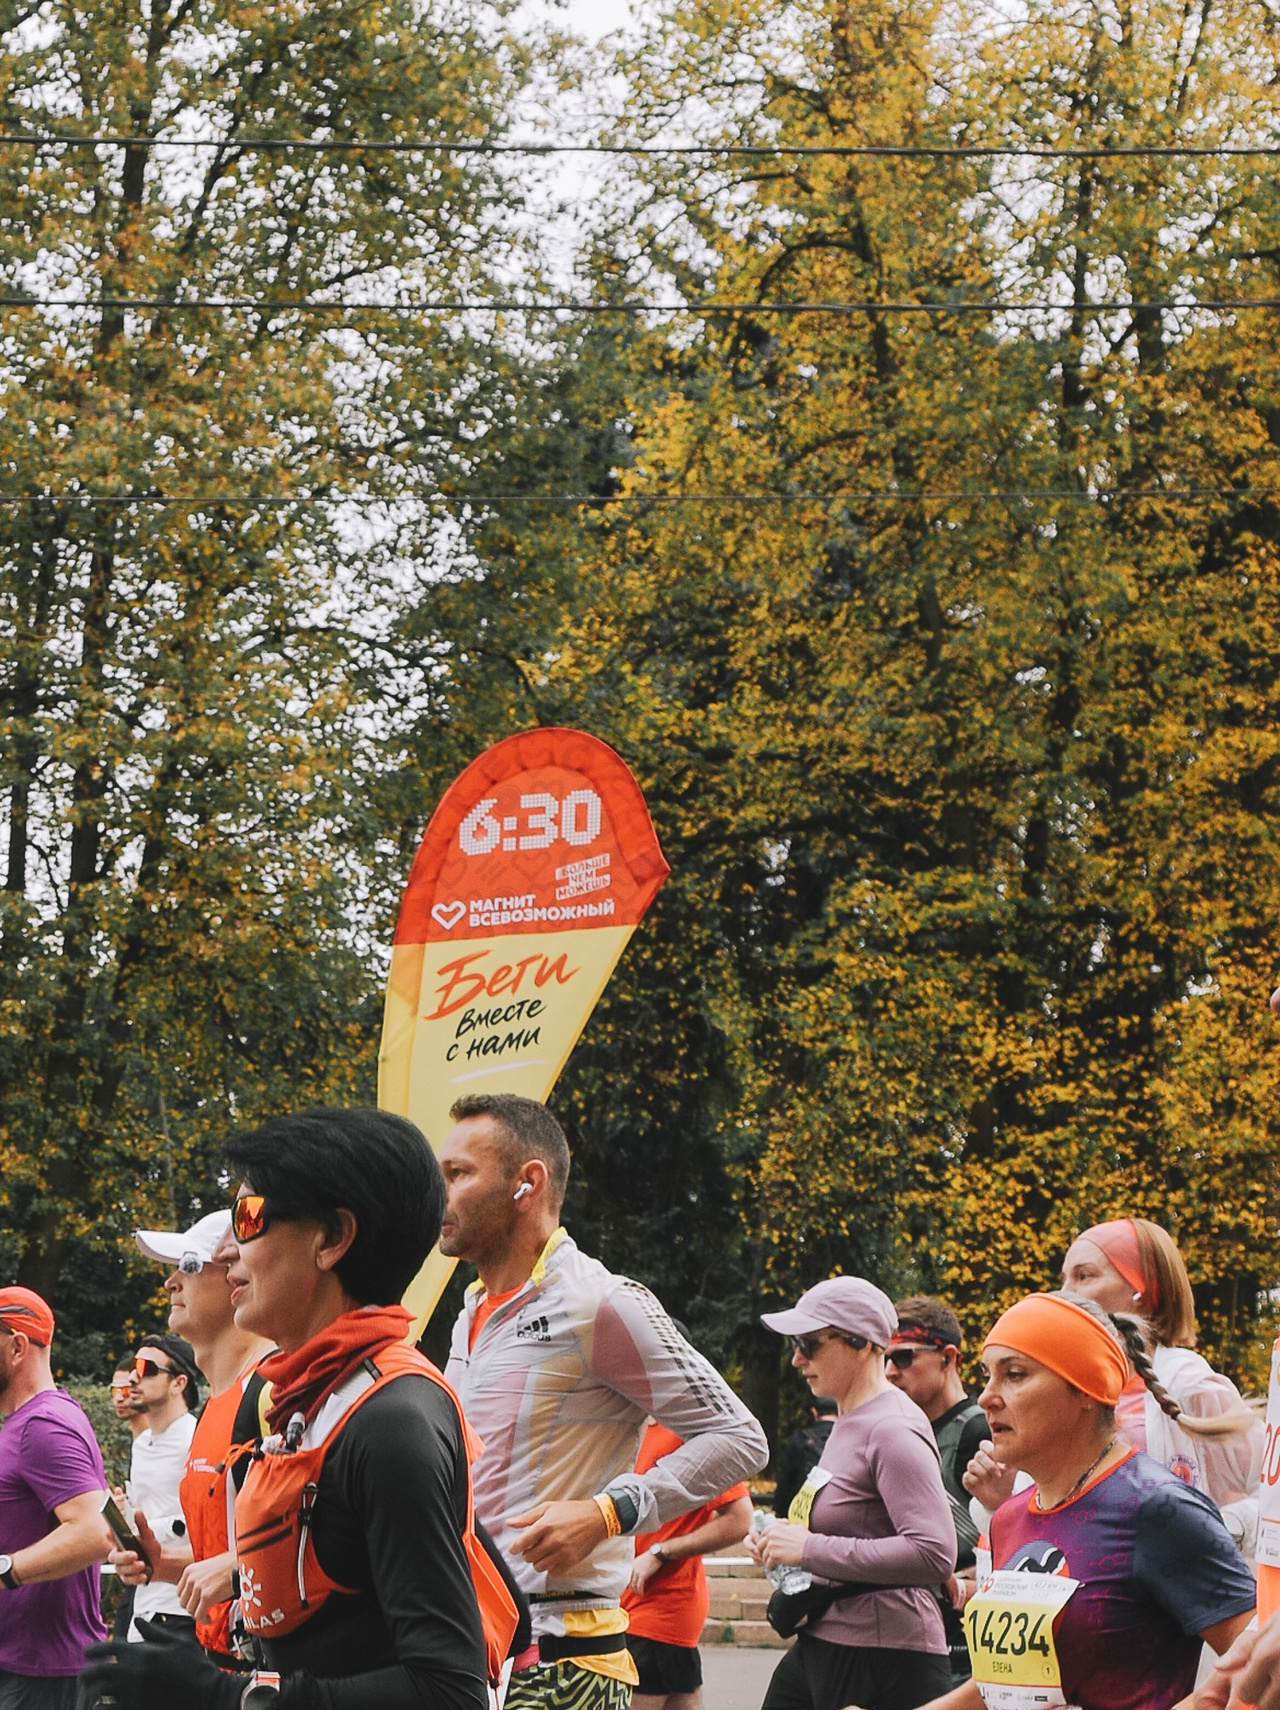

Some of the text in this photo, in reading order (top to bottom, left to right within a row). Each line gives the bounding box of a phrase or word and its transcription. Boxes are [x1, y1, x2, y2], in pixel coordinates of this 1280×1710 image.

[459, 788, 602, 856] 6:30
[562, 854, 608, 876] БОЛЬШЕ
[571, 870, 594, 883] ЧЕМ
[558, 876, 609, 899] МОЖЕШЬ
[469, 893, 536, 913] МАГНИТ
[469, 898, 616, 928] ВСЕВОЗМОЖНЫЙ
[424, 949, 582, 1021] Беги
[466, 1026, 541, 1061] нами
[243, 1608, 285, 1629] ILAS
[968, 1609, 1050, 1658] 14234
[992, 1661, 1014, 1675] ЕЛЕНА
